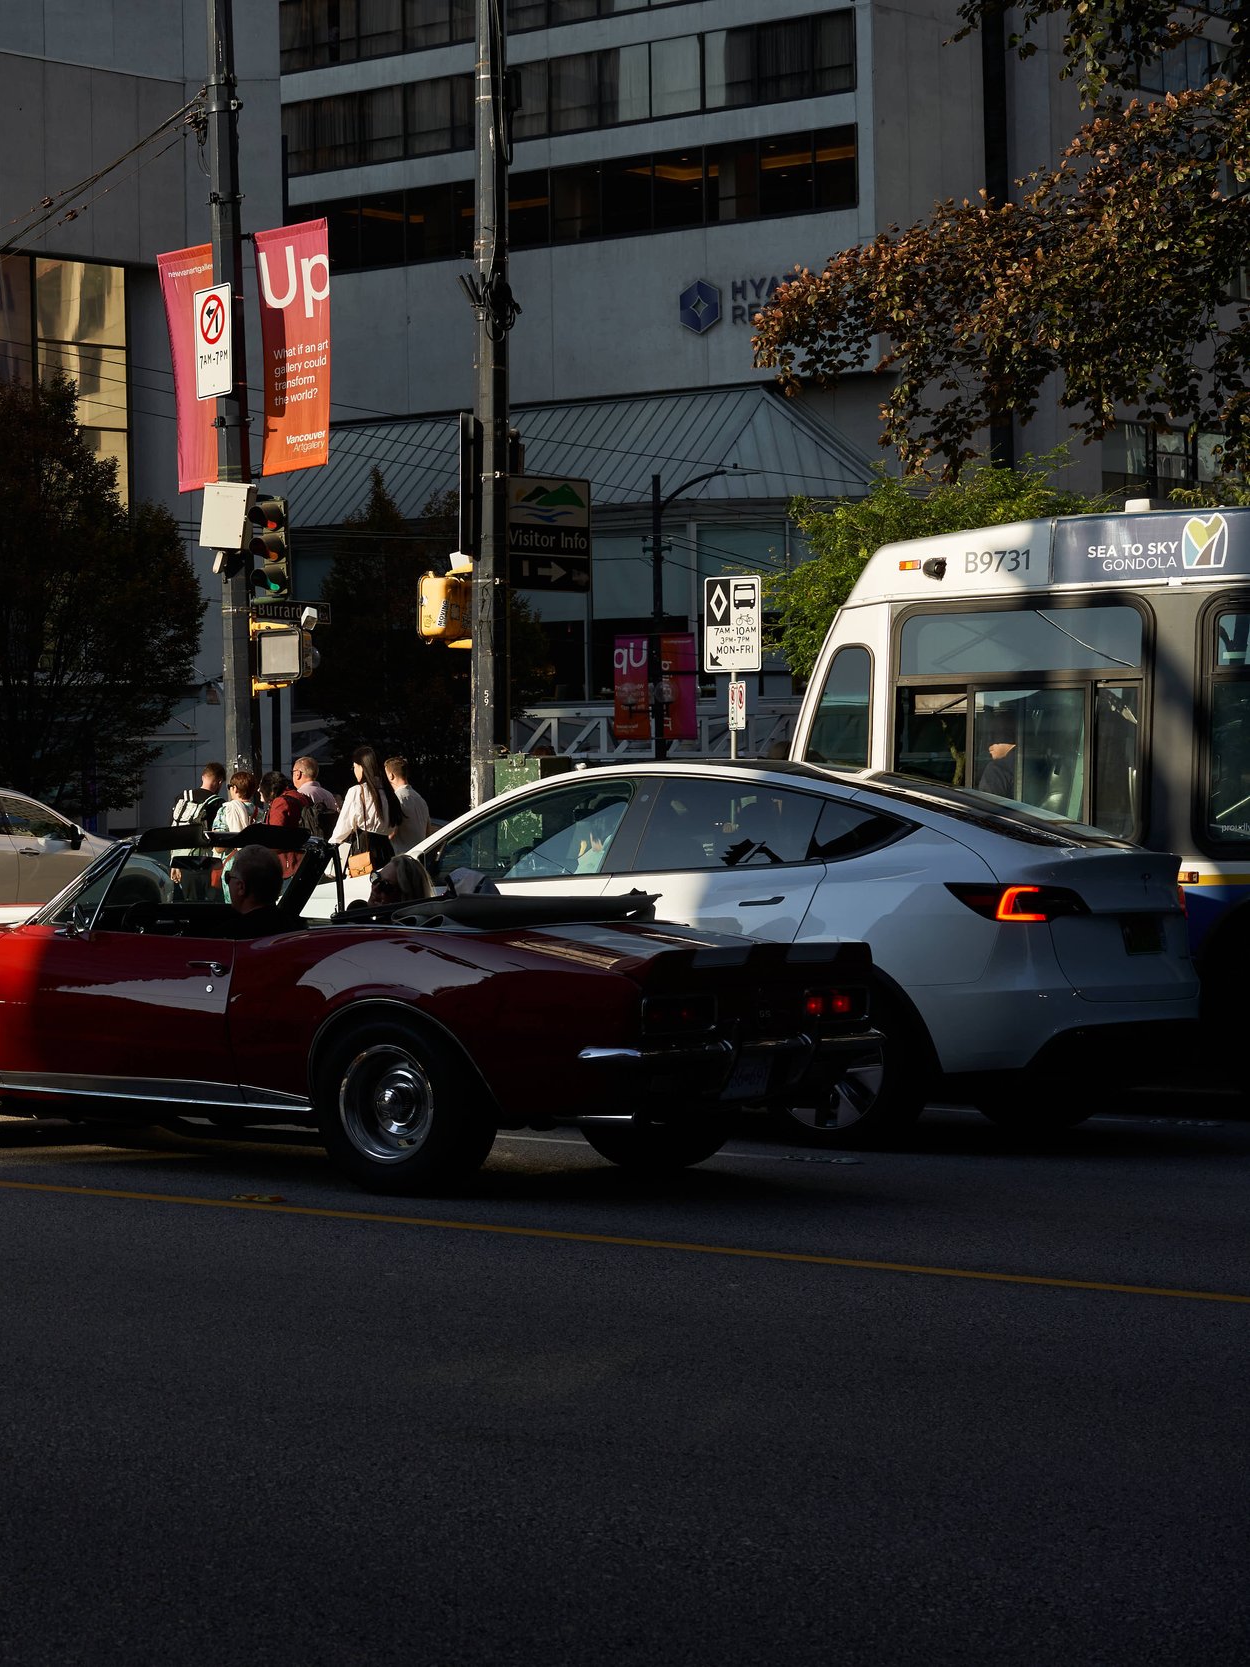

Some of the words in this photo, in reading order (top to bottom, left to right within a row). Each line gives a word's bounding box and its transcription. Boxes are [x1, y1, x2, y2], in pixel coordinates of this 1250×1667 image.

[257, 245, 329, 318] Up
[273, 346, 296, 360] What
[297, 343, 304, 356] if
[305, 344, 317, 354] an
[317, 339, 329, 352] art
[274, 361, 303, 378] gallery
[303, 354, 327, 370] could
[274, 374, 316, 391] transform
[274, 395, 289, 407] the
[290, 387, 318, 403] world?
[286, 430, 326, 445] Vancouver
[509, 529, 556, 548] Visitor
[560, 531, 588, 550] Info
[1087, 545, 1119, 559] SEA
[1121, 543, 1144, 558] TO
[1147, 541, 1179, 555] SKY
[964, 548, 1031, 574] B9731
[1102, 556, 1178, 572] GONDOLA
[258, 603, 302, 619] Burrard
[716, 645, 754, 655] MON-FRI
